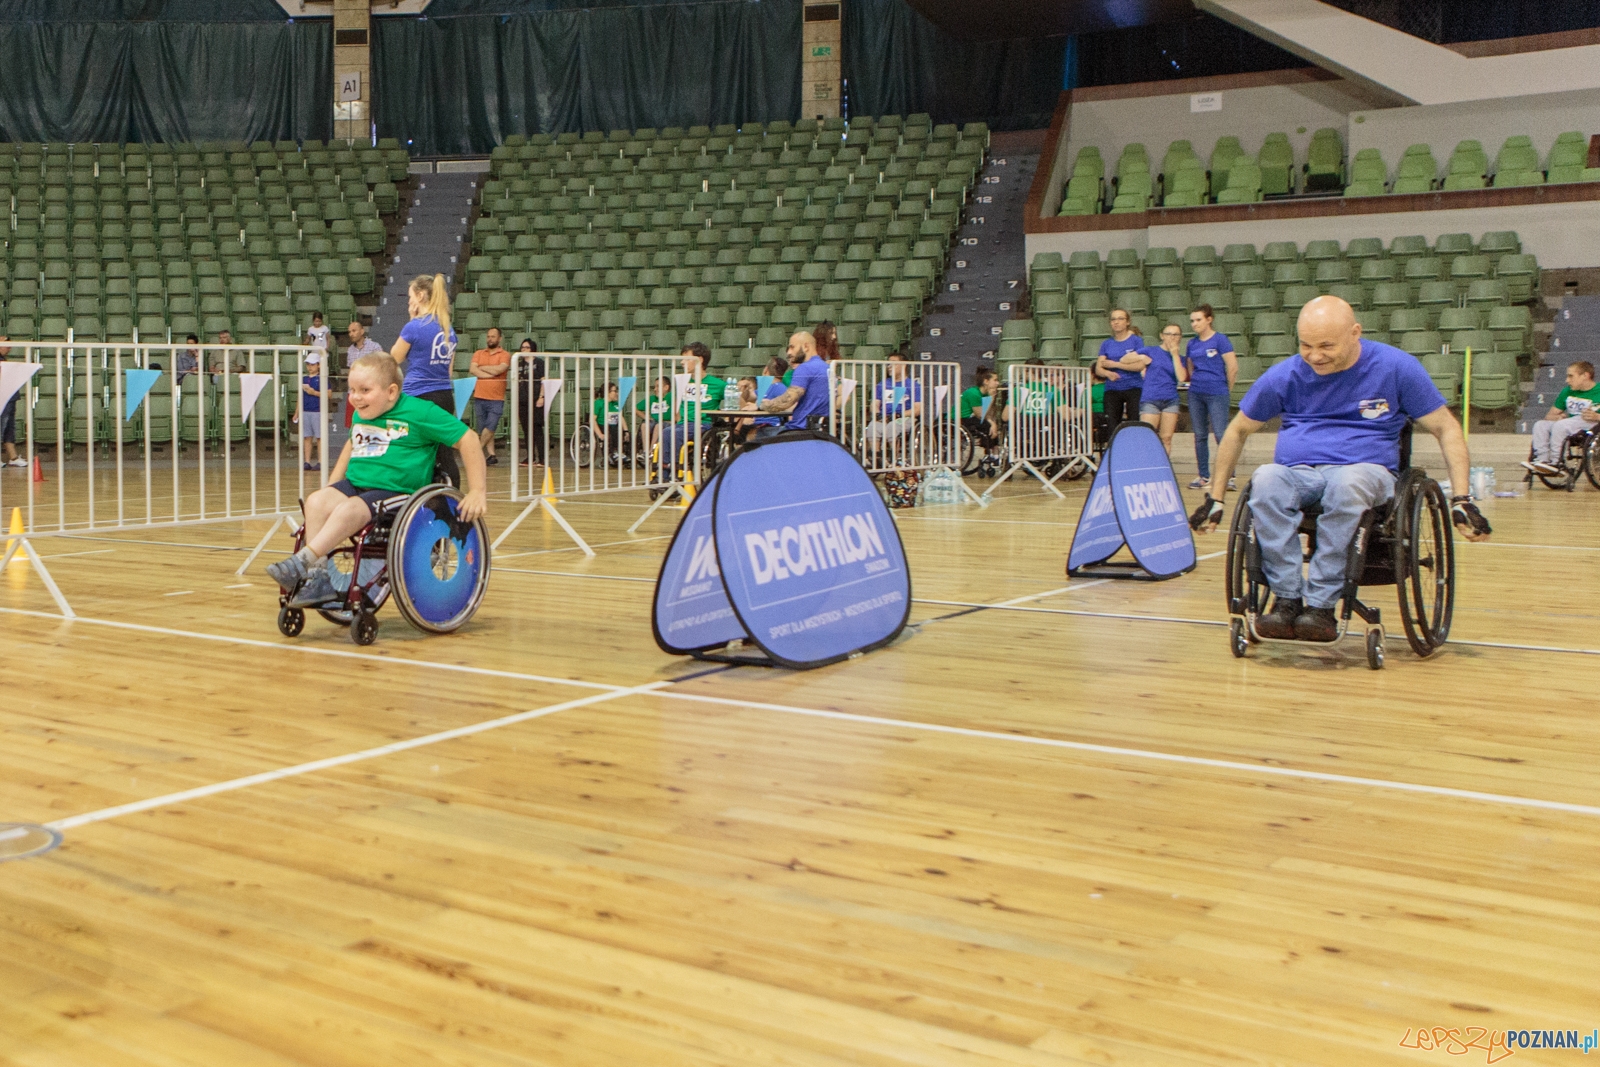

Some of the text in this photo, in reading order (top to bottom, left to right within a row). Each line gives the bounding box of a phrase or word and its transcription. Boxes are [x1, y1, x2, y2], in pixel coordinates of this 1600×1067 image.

[343, 80, 357, 94] A1
[990, 158, 1007, 166] 14
[983, 176, 1000, 184] 13
[975, 196, 993, 204] 12
[970, 216, 985, 224] 11
[960, 237, 978, 246] 10
[955, 260, 967, 268] 9
[949, 283, 960, 291] 8
[1007, 280, 1018, 289] 7
[999, 302, 1011, 311] 6
[1563, 309, 1571, 319] 5
[930, 328, 941, 336] 6
[991, 326, 1002, 335] 5
[920, 352, 932, 360] 5
[982, 350, 995, 359] 4
[1548, 368, 1556, 378] 3
[1537, 393, 1545, 404] 2
[332, 423, 338, 432] 2
[1521, 422, 1527, 432] 1
[1123, 481, 1180, 520] DECATHLON
[744, 511, 885, 585] DECATHLON
